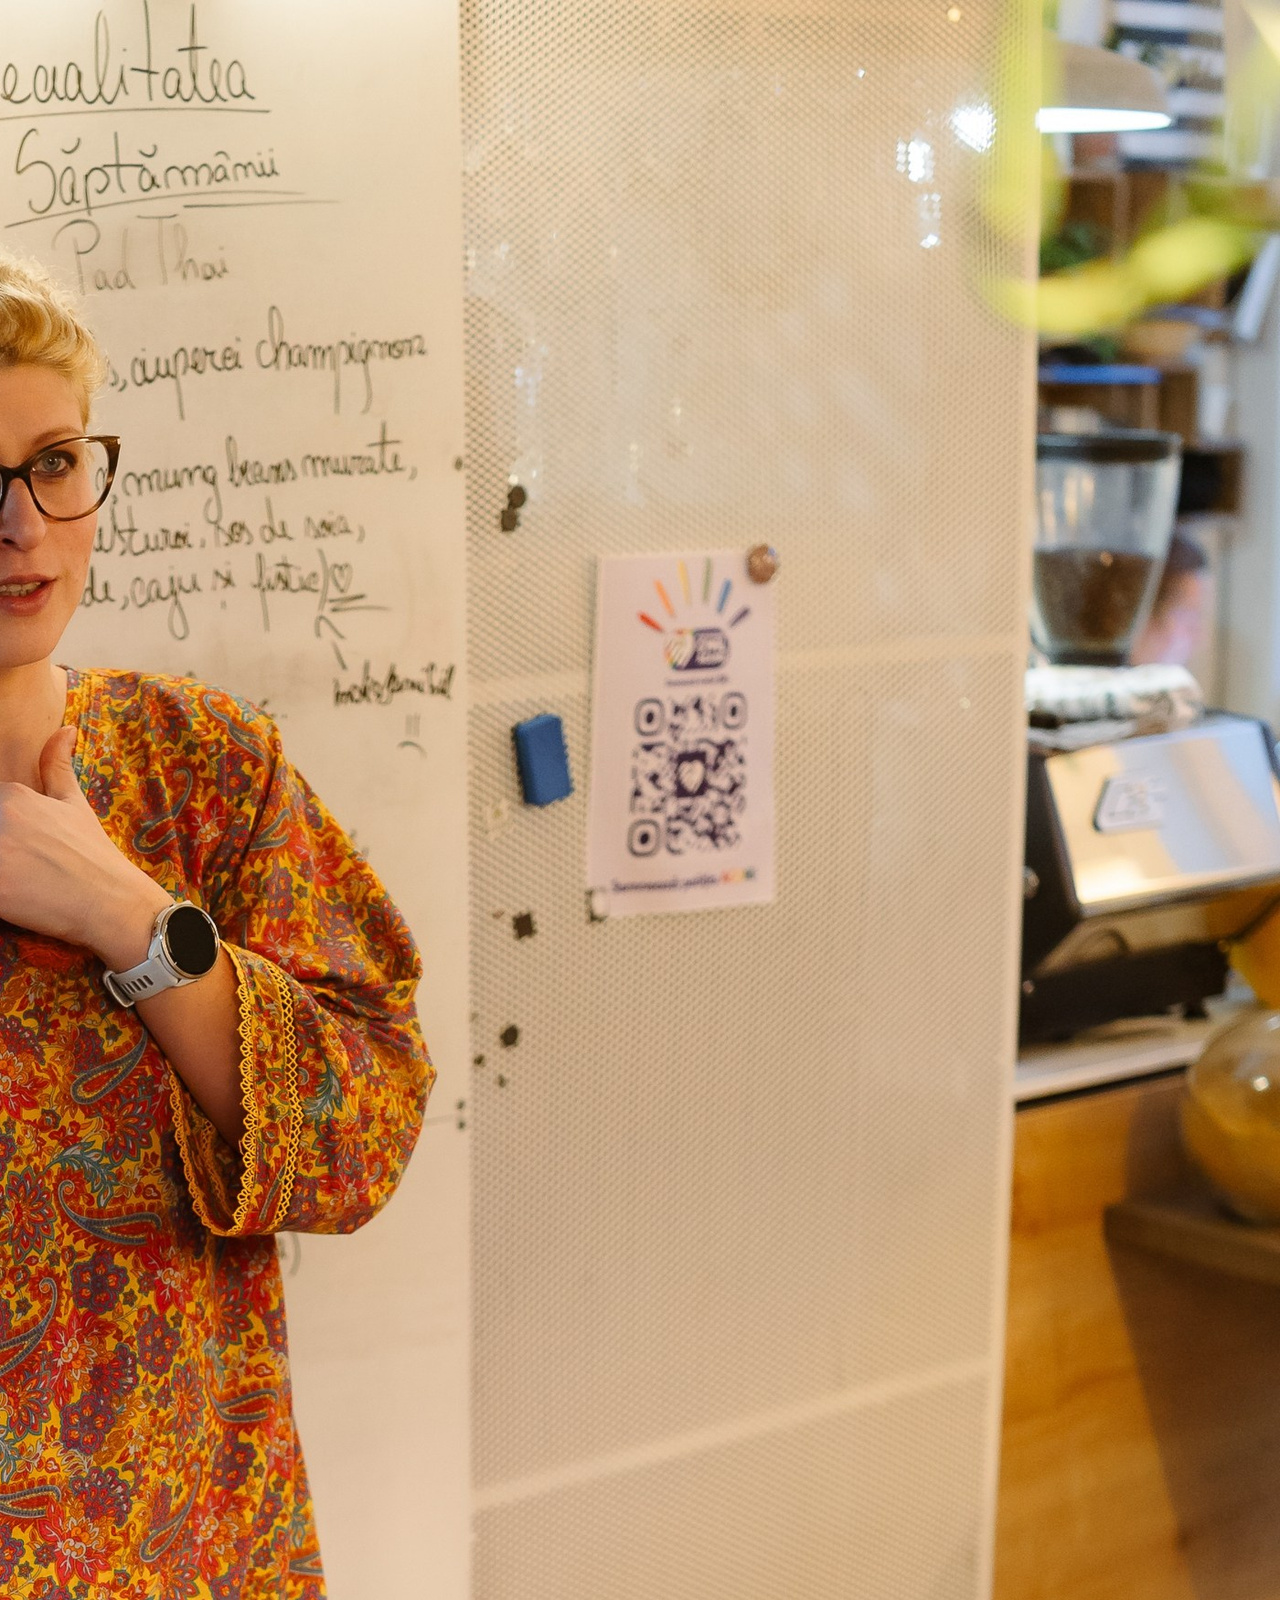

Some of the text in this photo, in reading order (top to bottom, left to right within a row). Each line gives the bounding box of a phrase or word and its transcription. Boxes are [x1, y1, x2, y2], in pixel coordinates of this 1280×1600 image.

[15, 128, 280, 213] Săptămânii
[52, 213, 230, 296] Pad Thai
[259, 496, 295, 544] de
